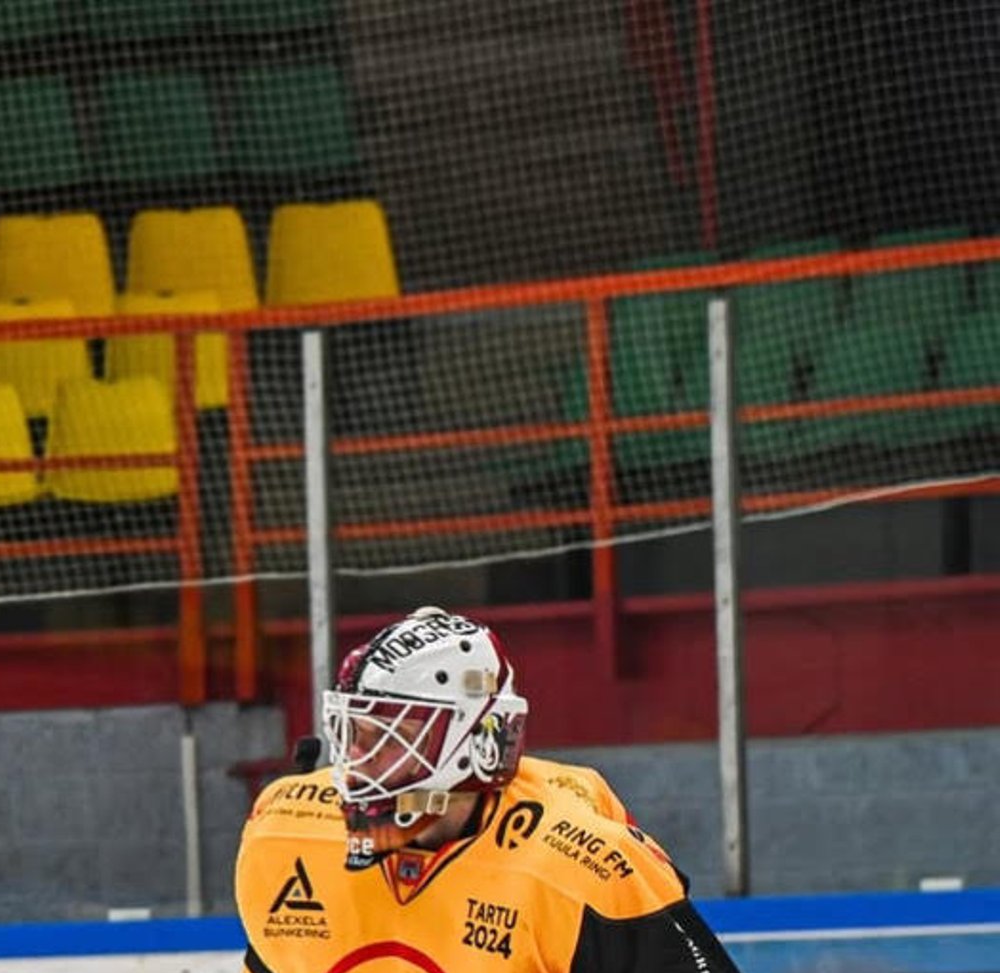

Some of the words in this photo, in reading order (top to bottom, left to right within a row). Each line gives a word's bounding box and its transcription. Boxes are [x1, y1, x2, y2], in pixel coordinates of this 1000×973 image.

[551, 819, 606, 856] RING
[603, 850, 634, 879] FM
[267, 915, 328, 927] ALEXELA
[467, 898, 518, 930] TARTU
[263, 928, 332, 940] BUNKERING
[462, 922, 512, 960] 2024
